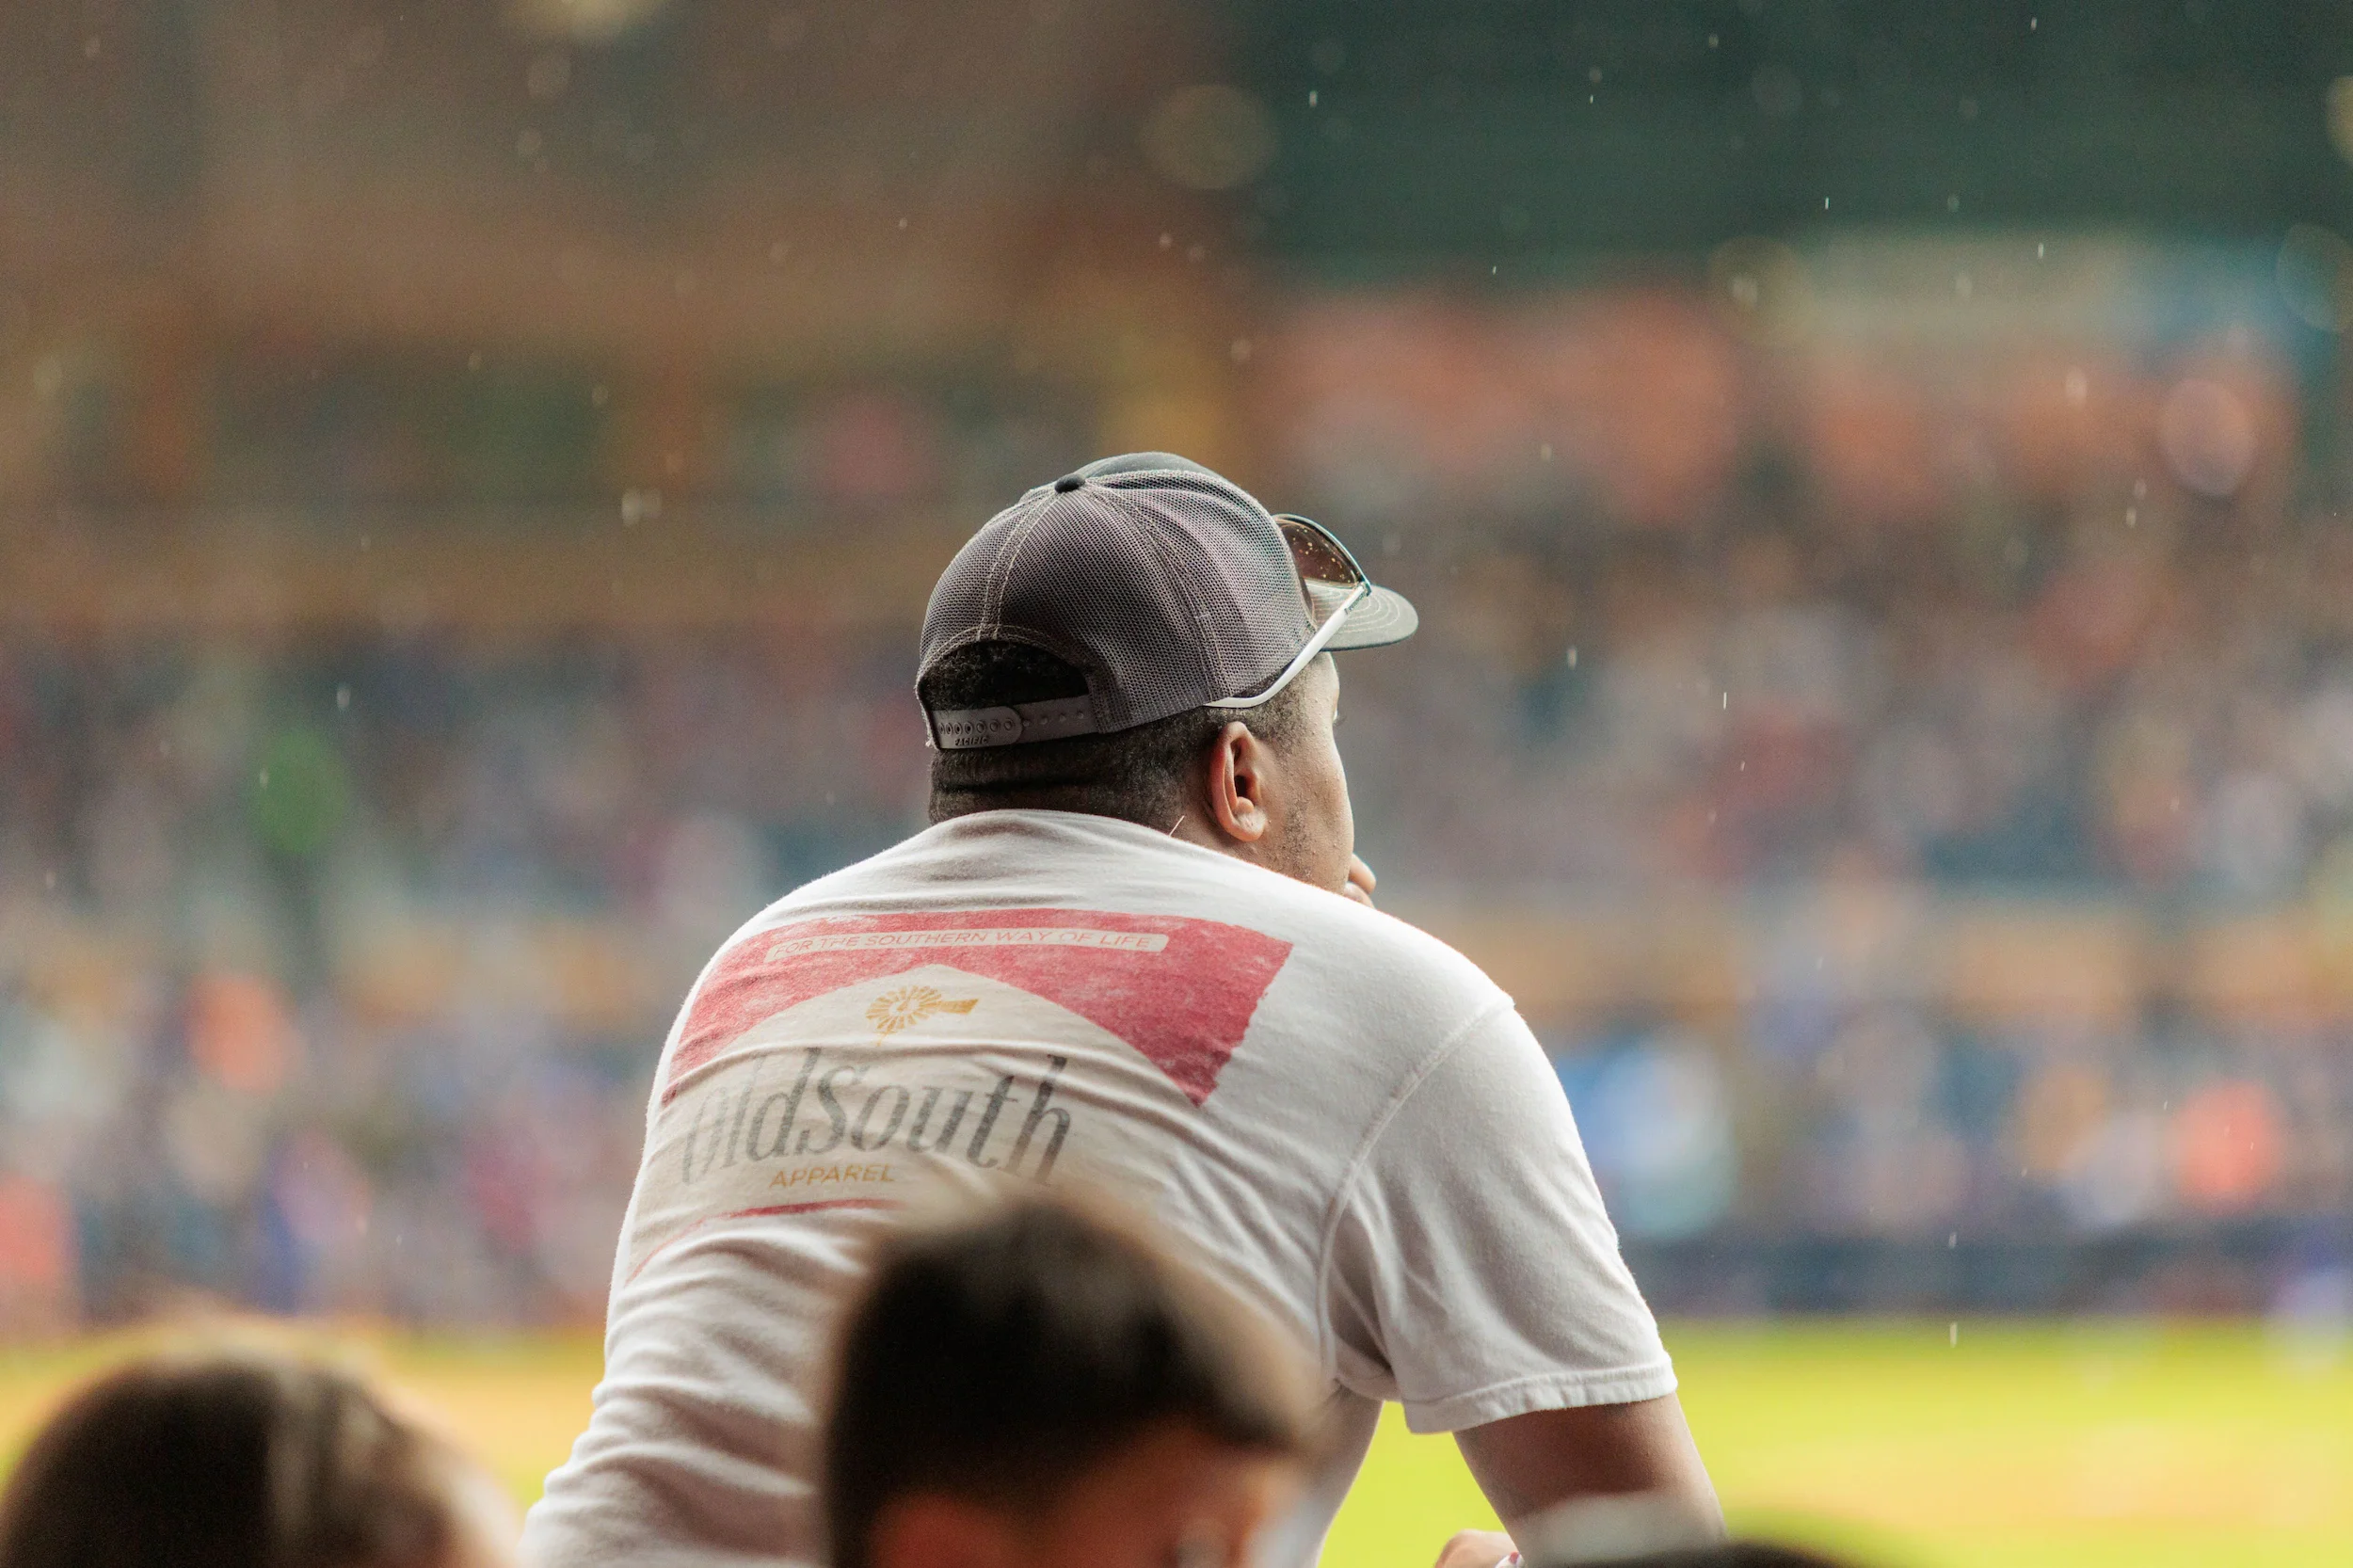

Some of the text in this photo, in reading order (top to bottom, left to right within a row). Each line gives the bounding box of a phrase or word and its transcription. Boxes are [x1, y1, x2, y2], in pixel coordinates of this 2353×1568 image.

[954, 736, 988, 746] PACIFIC
[774, 931, 1152, 957] FOR THE SOUTHERN WAY OF LIFE
[769, 1163, 896, 1189] APPAREL
